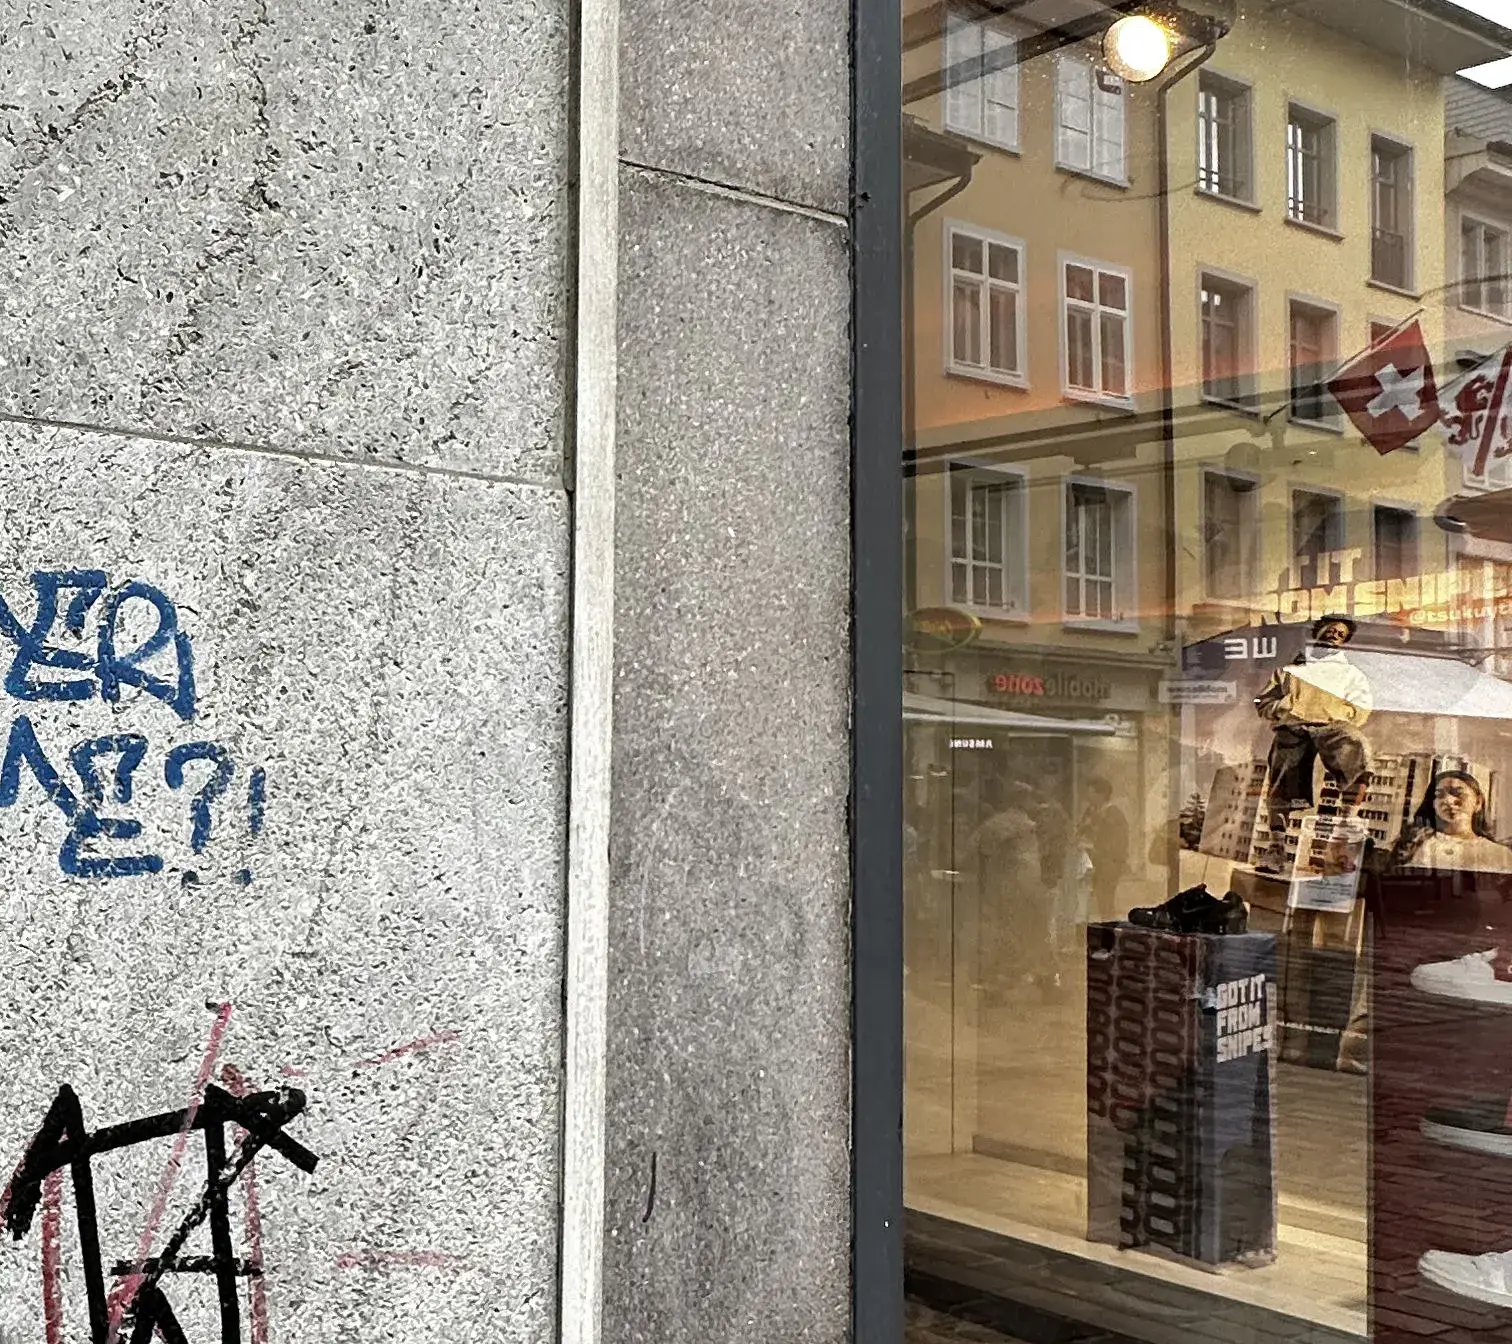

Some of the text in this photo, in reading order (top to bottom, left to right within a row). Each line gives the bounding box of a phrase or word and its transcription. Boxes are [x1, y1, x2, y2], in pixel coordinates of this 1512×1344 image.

[1353, 566, 1512, 618] SNIPE
[1216, 973, 1265, 1010] GOT IT
[1216, 1000, 1261, 1037] FROM
[1216, 1025, 1274, 1063] SNIPES
